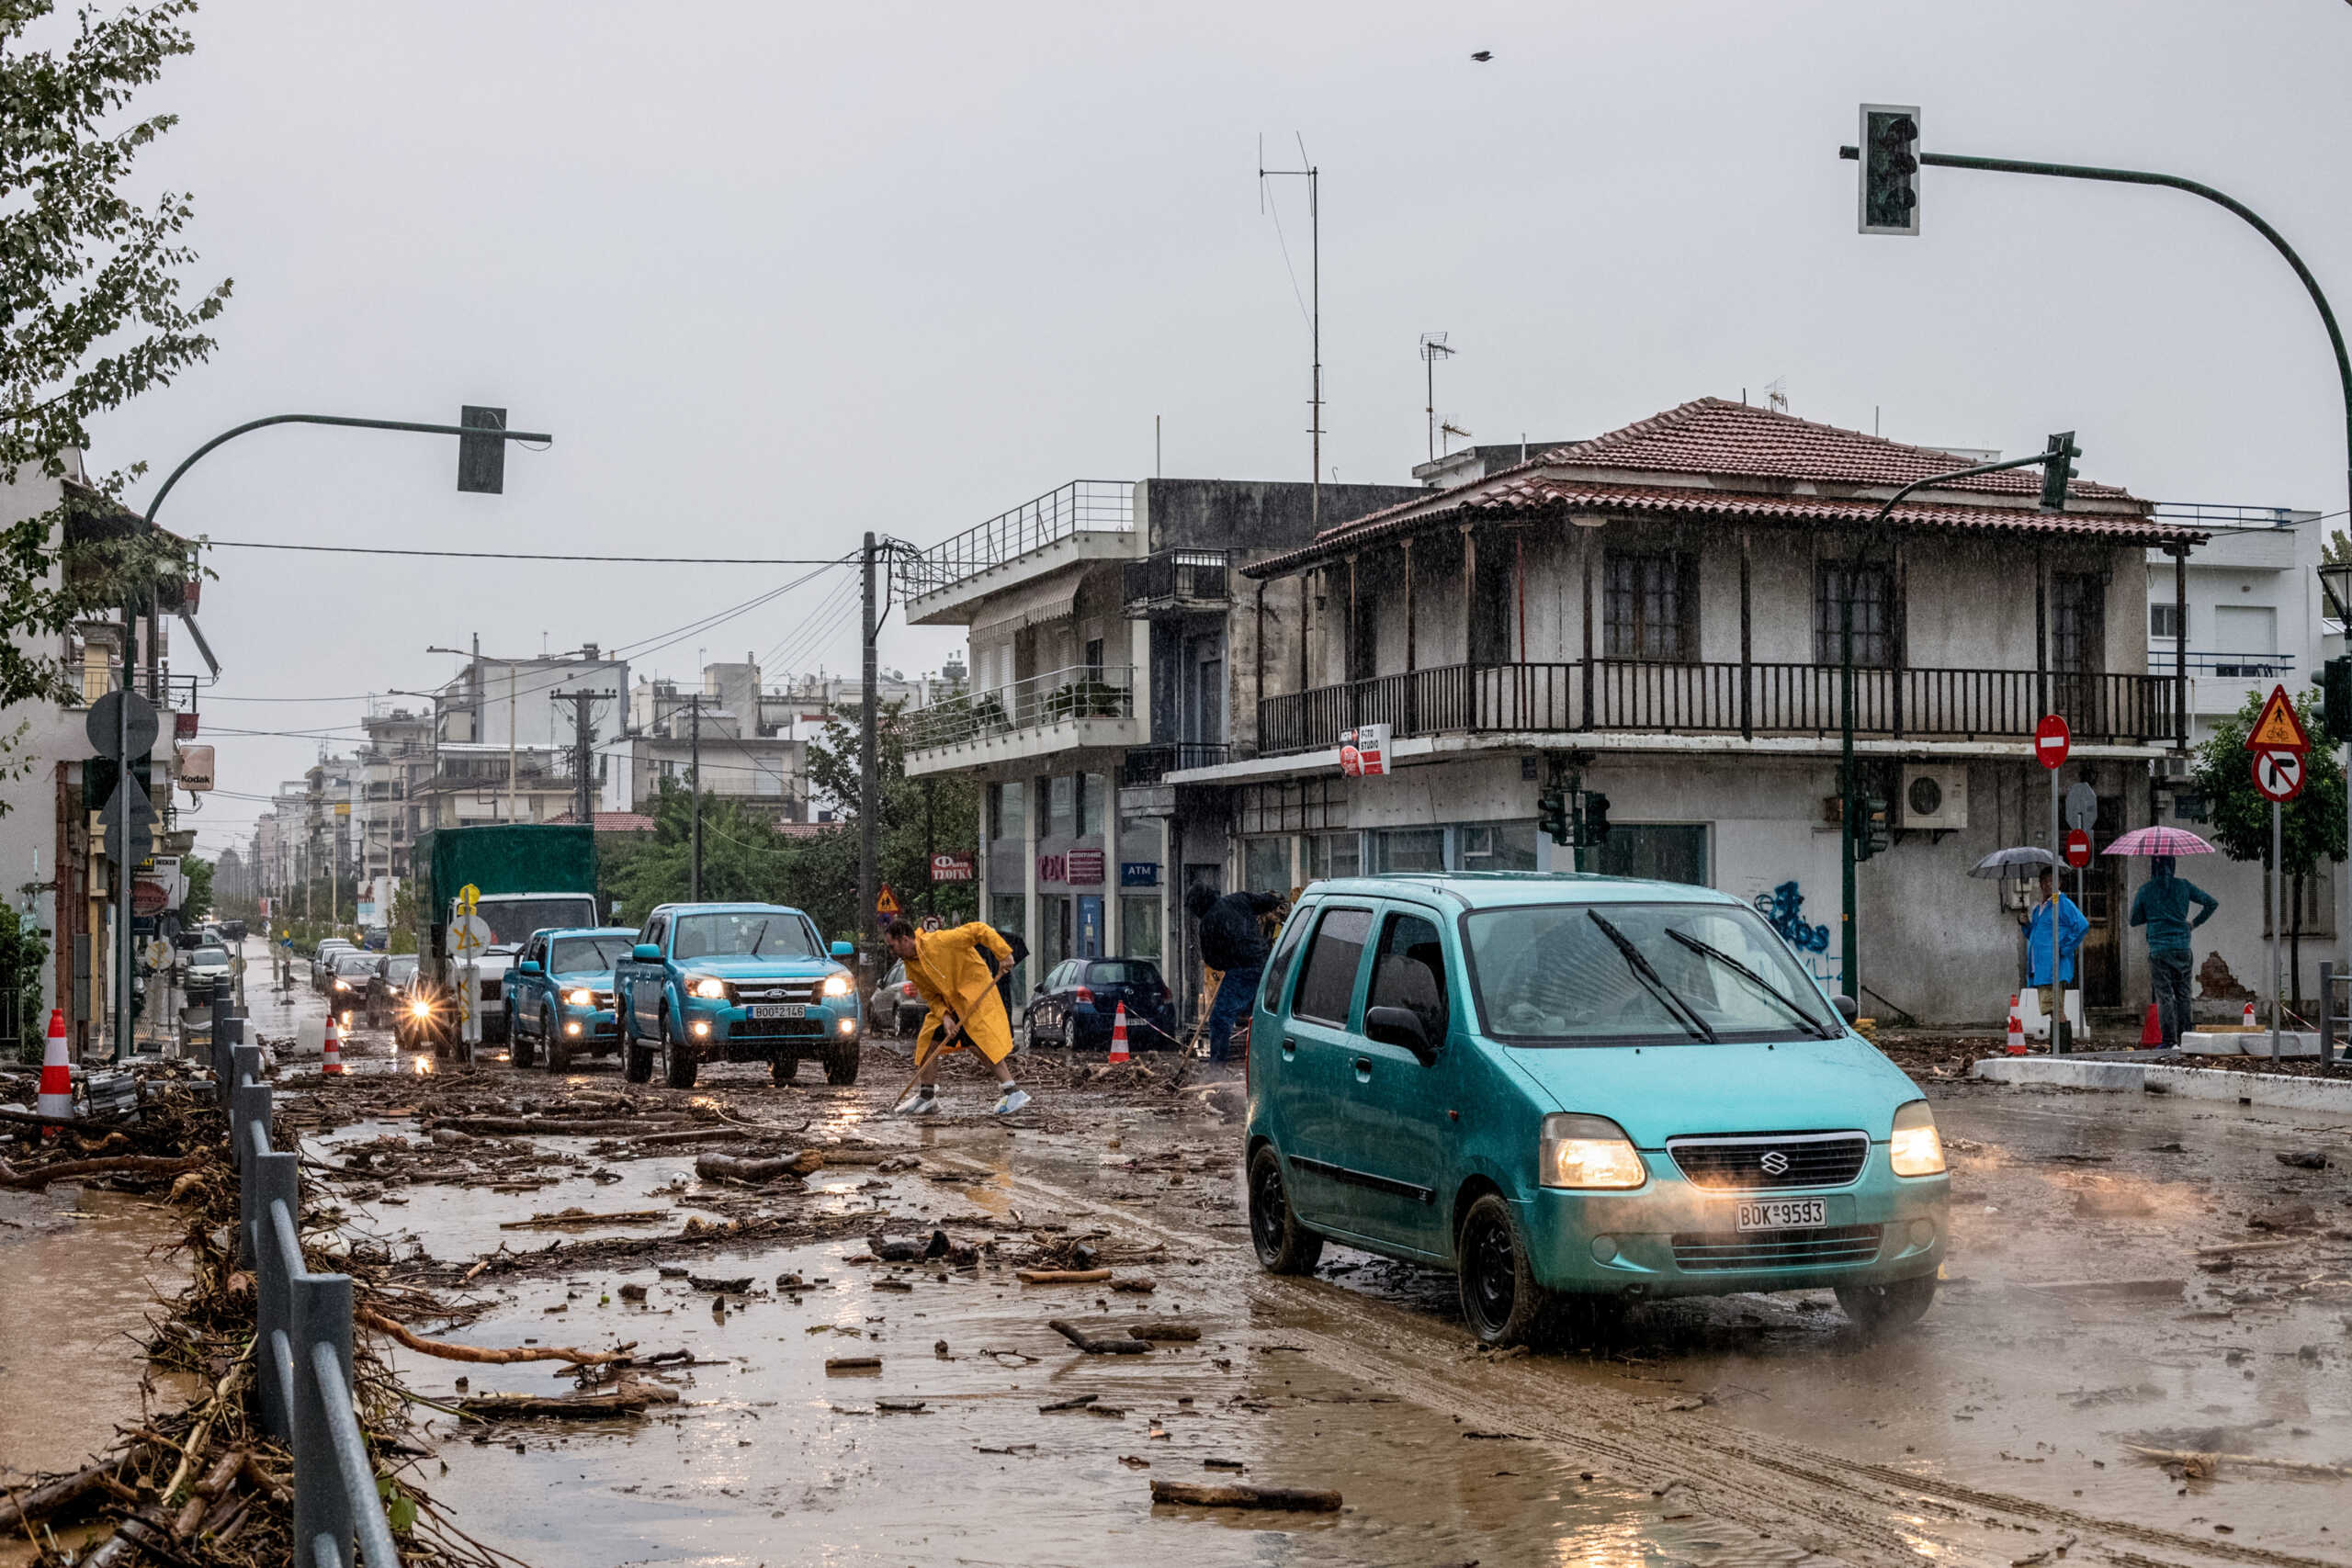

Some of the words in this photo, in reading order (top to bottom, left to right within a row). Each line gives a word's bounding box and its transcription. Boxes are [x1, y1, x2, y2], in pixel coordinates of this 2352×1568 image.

[1361, 739, 1379, 750] STUDIO
[181, 775, 210, 784] Kodak
[1127, 865, 1152, 875] ATM
